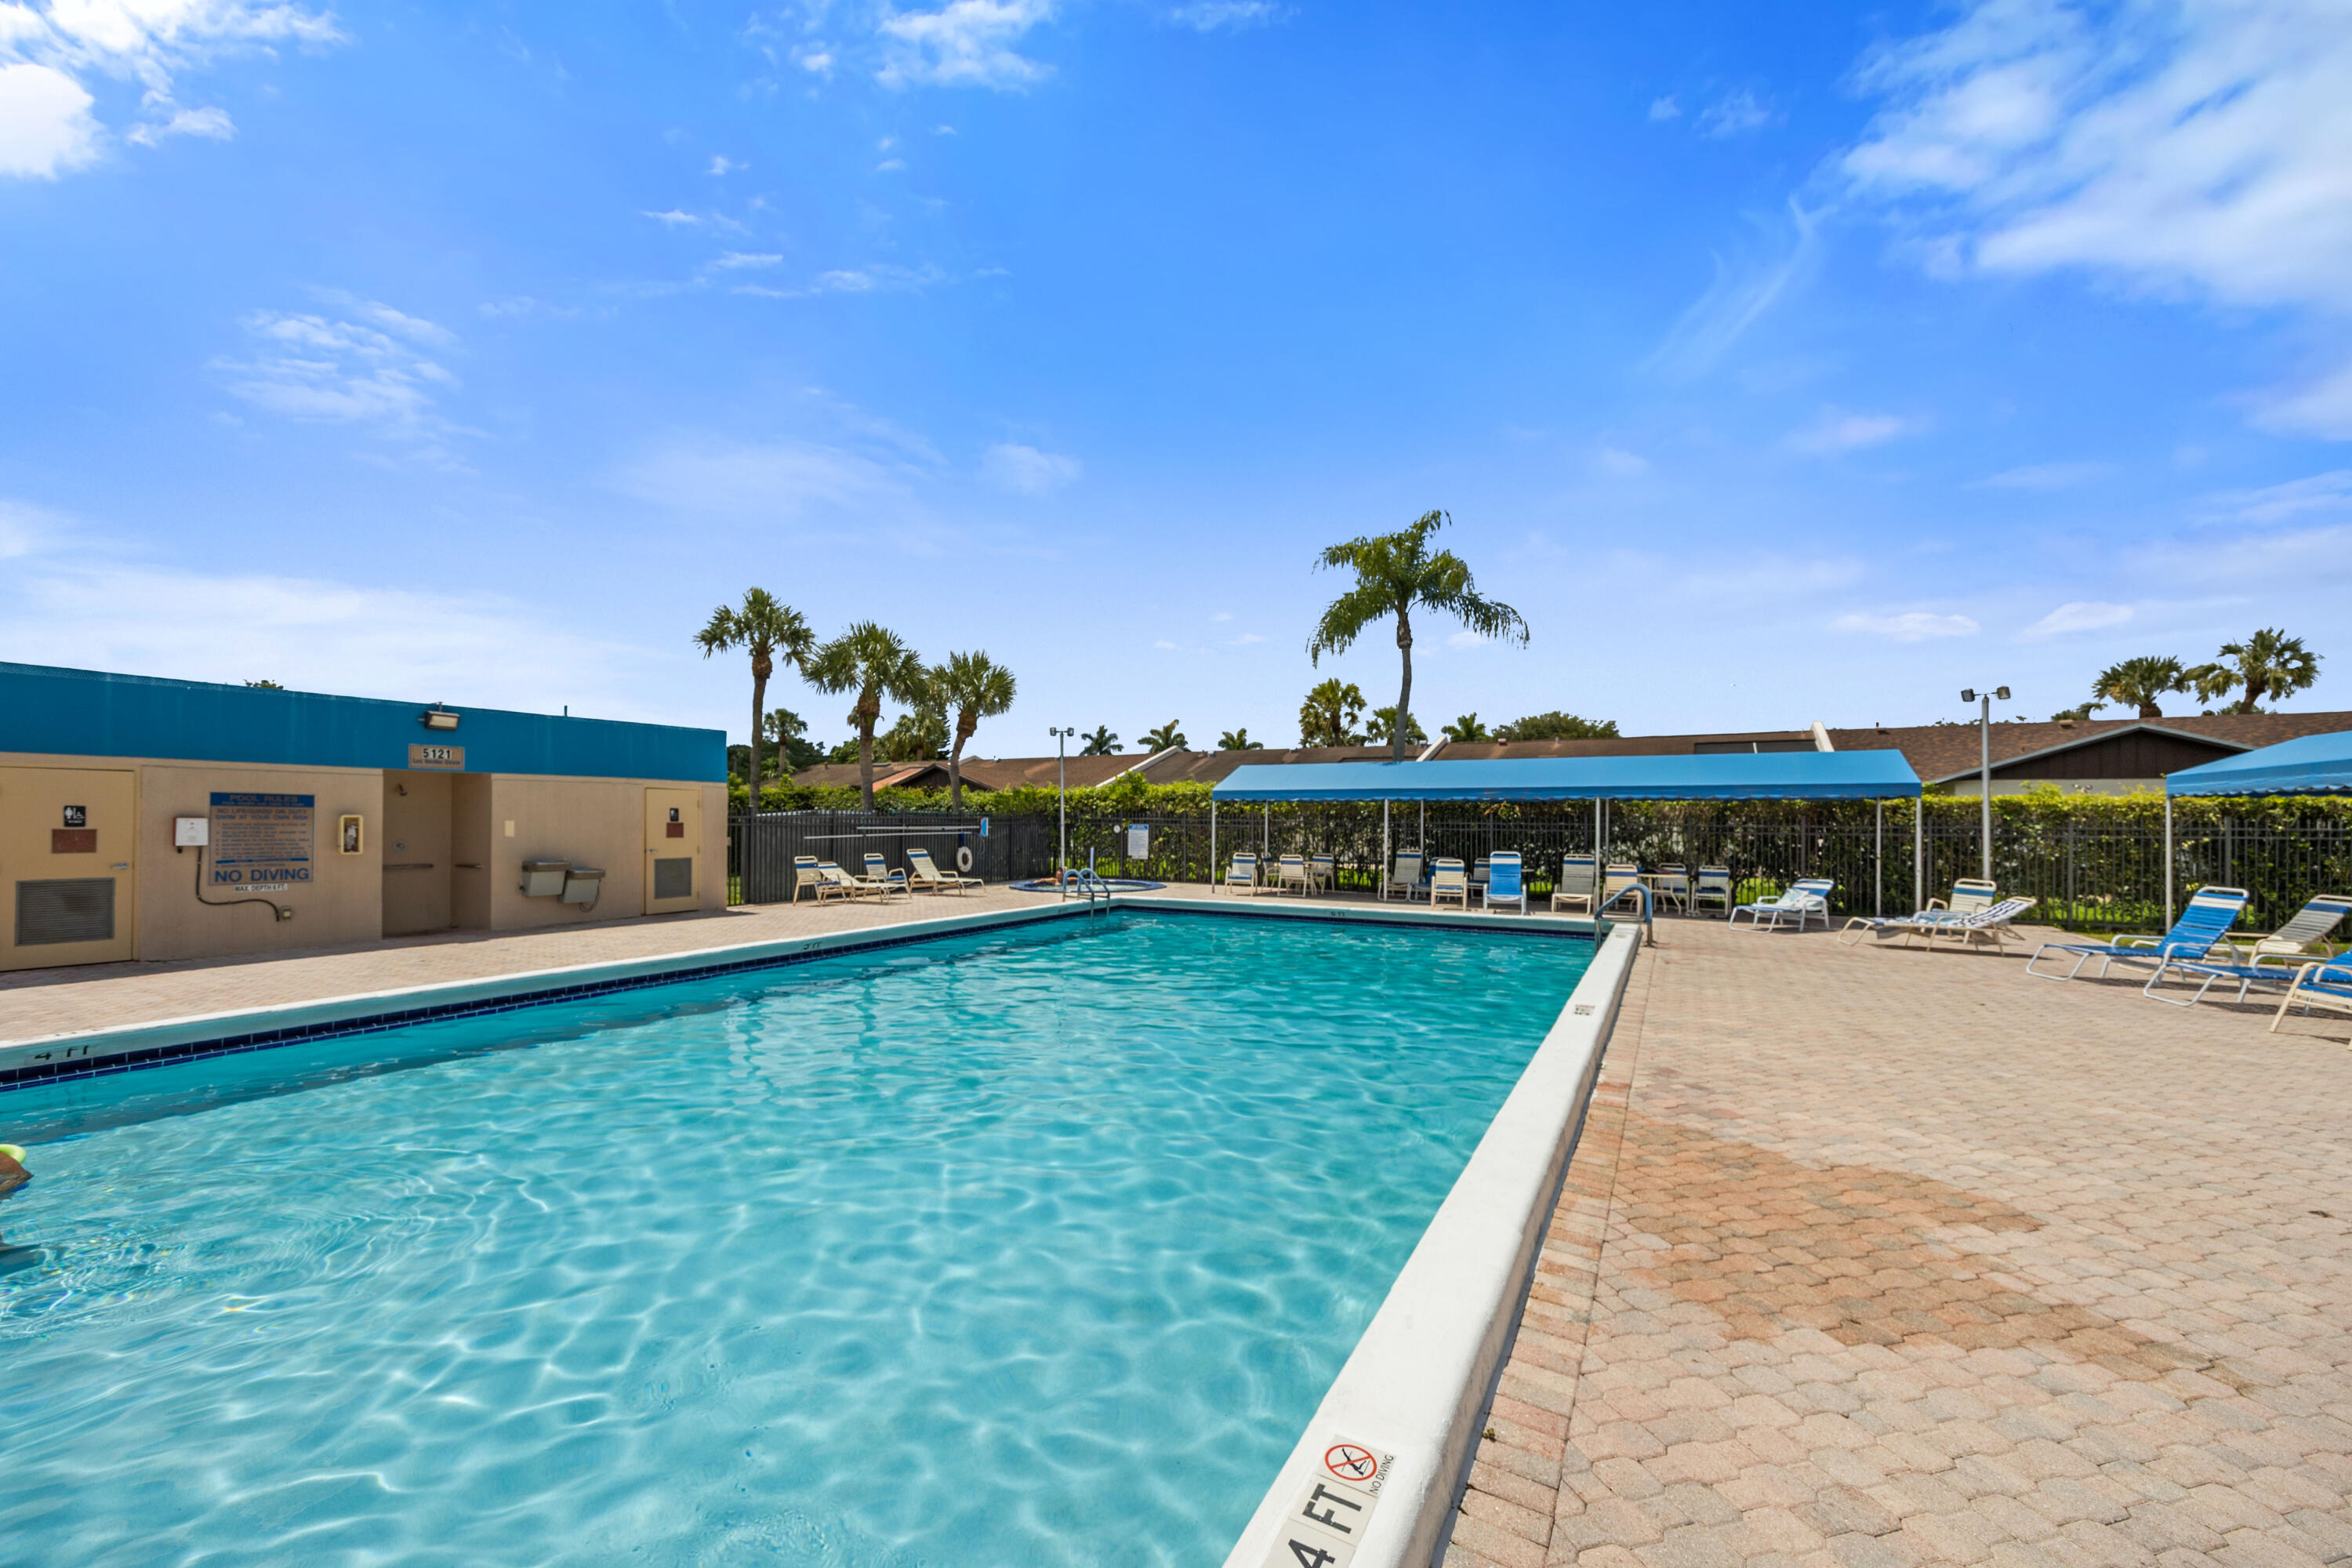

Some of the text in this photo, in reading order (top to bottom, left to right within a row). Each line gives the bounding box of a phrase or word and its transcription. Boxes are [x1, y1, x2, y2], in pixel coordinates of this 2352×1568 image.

[423, 748, 451, 759] 5121
[214, 868, 309, 883] NO DIVING
[1369, 1454, 1395, 1494] NO DIVING
[1288, 1483, 1363, 1568] 4 FT
